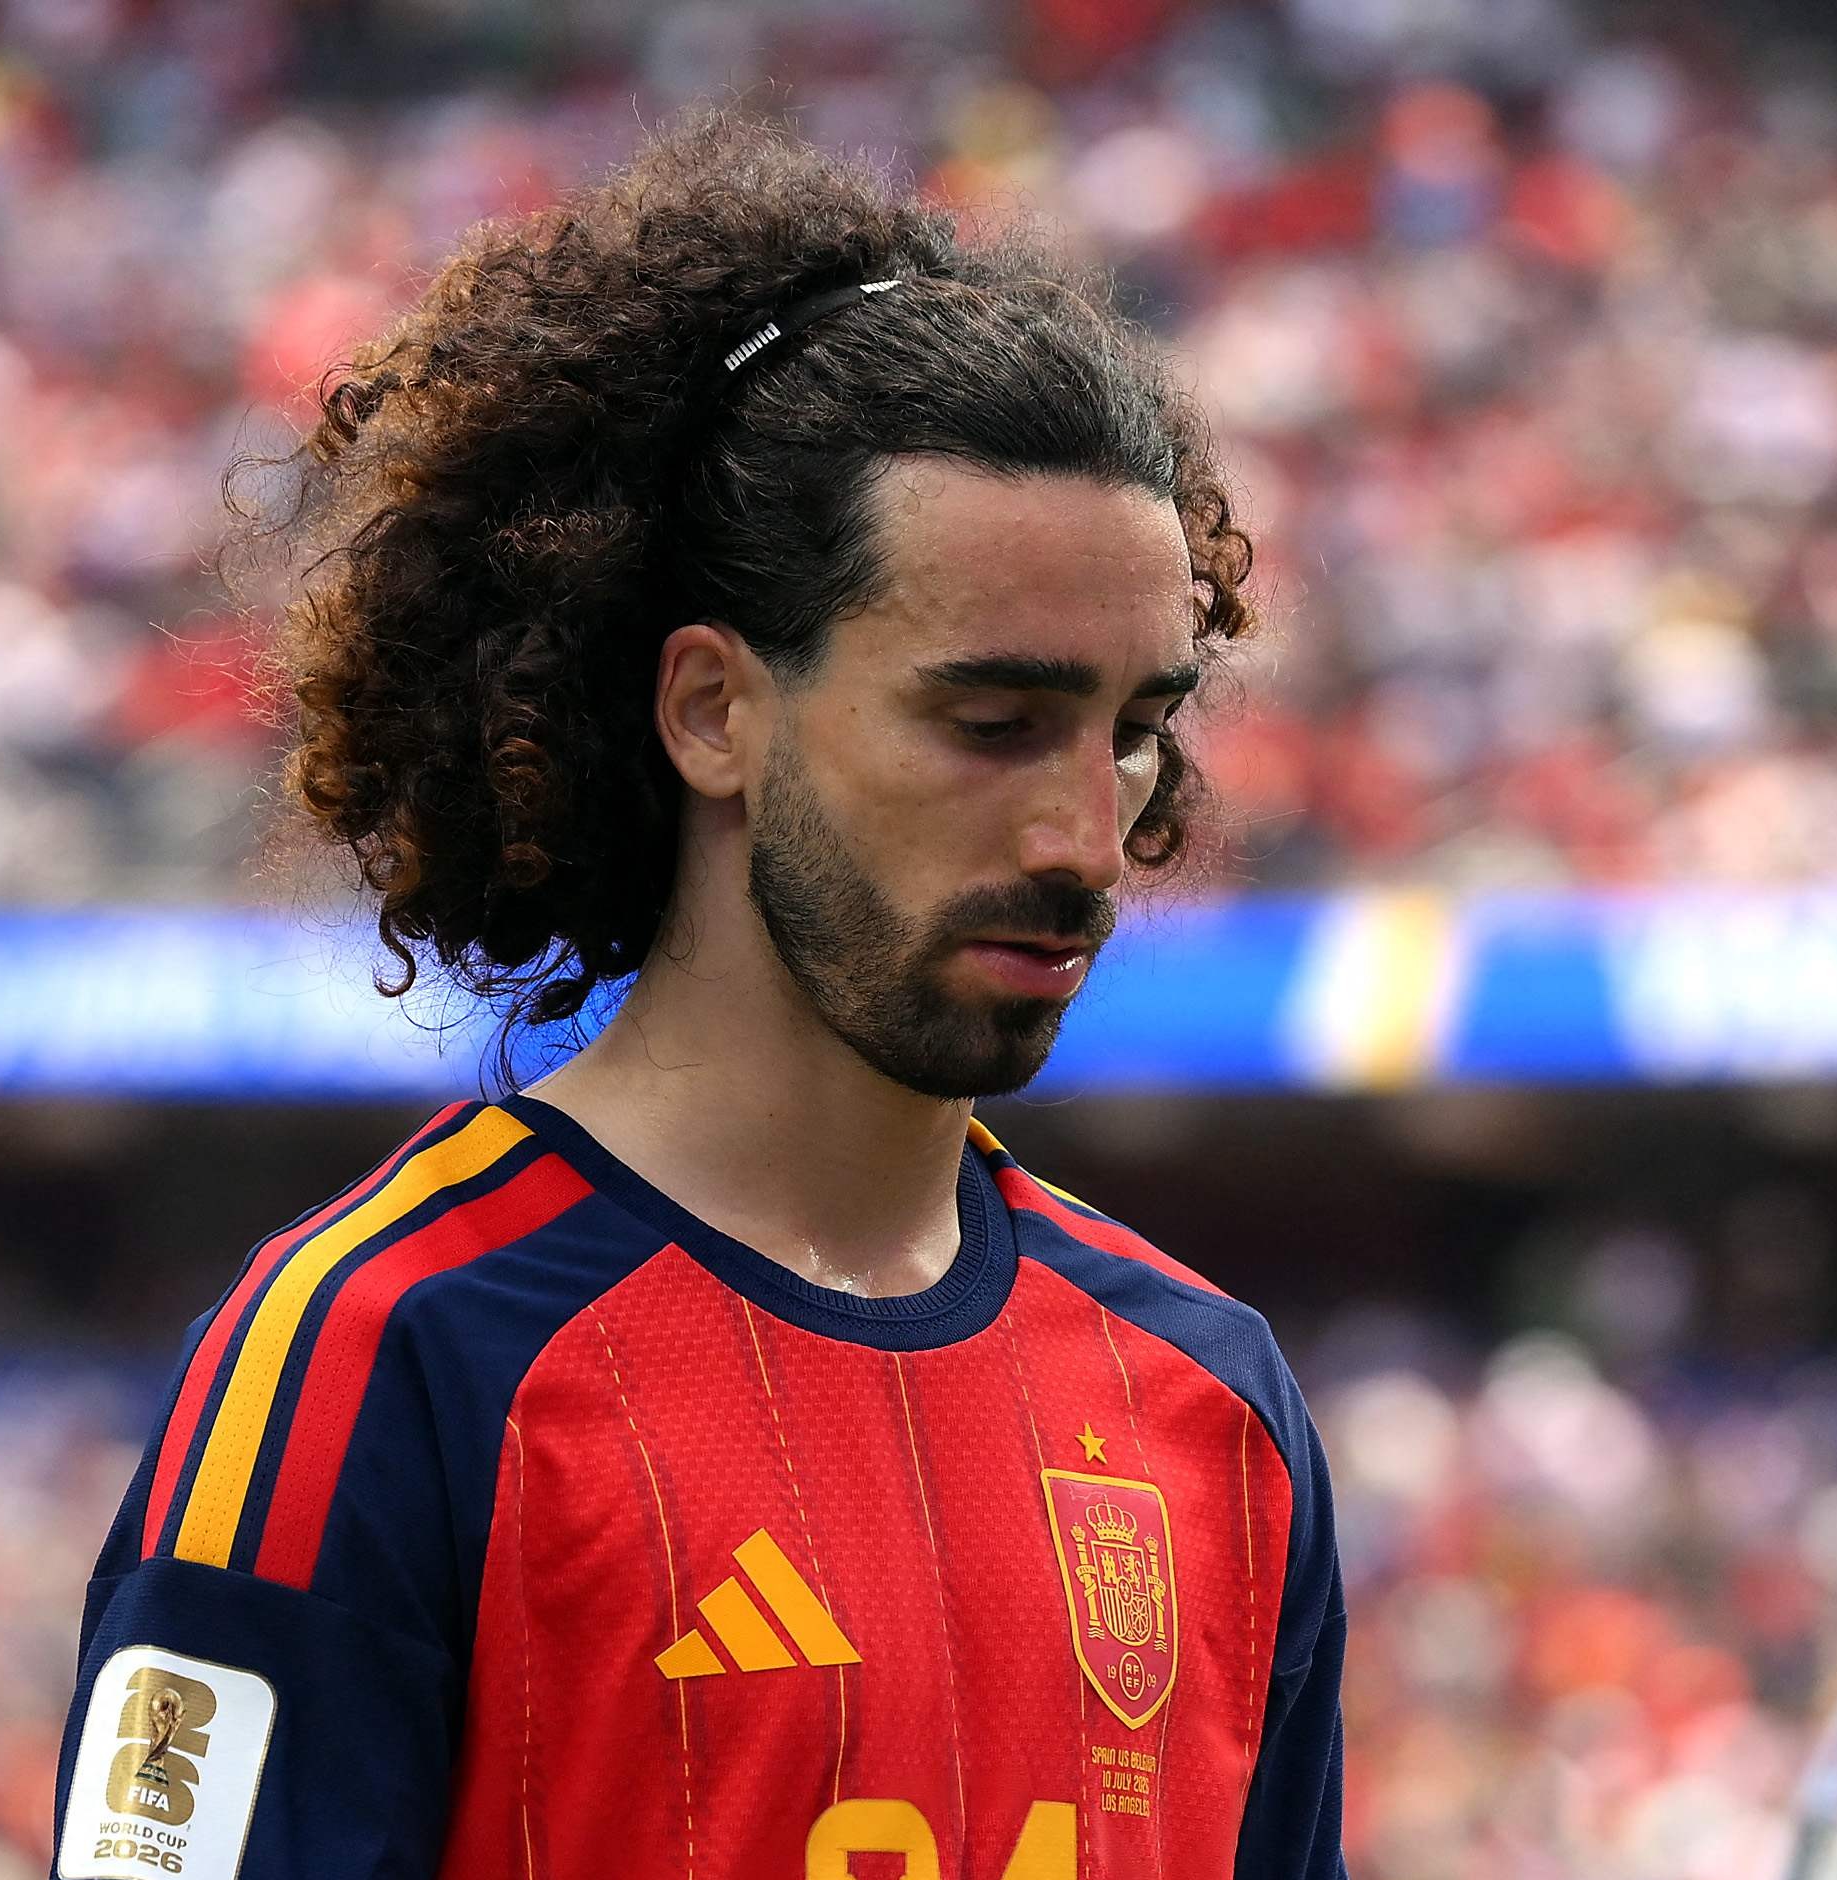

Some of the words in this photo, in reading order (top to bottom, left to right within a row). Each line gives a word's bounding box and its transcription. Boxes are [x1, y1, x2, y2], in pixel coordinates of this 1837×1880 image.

[1125, 1663, 1140, 1675] RF
[1125, 1676, 1140, 1689] EF
[1091, 1745, 1116, 1765] SPAIN
[1102, 1770, 1111, 1789] 10
[1112, 1771, 1132, 1791] JULY
[127, 1785, 170, 1813] FIFA
[1101, 1793, 1117, 1812] LOS
[1118, 1795, 1150, 1819] ANGELES
[100, 1822, 153, 1839] WORLD
[157, 1831, 188, 1850] CUP
[94, 1839, 183, 1874] 2026
